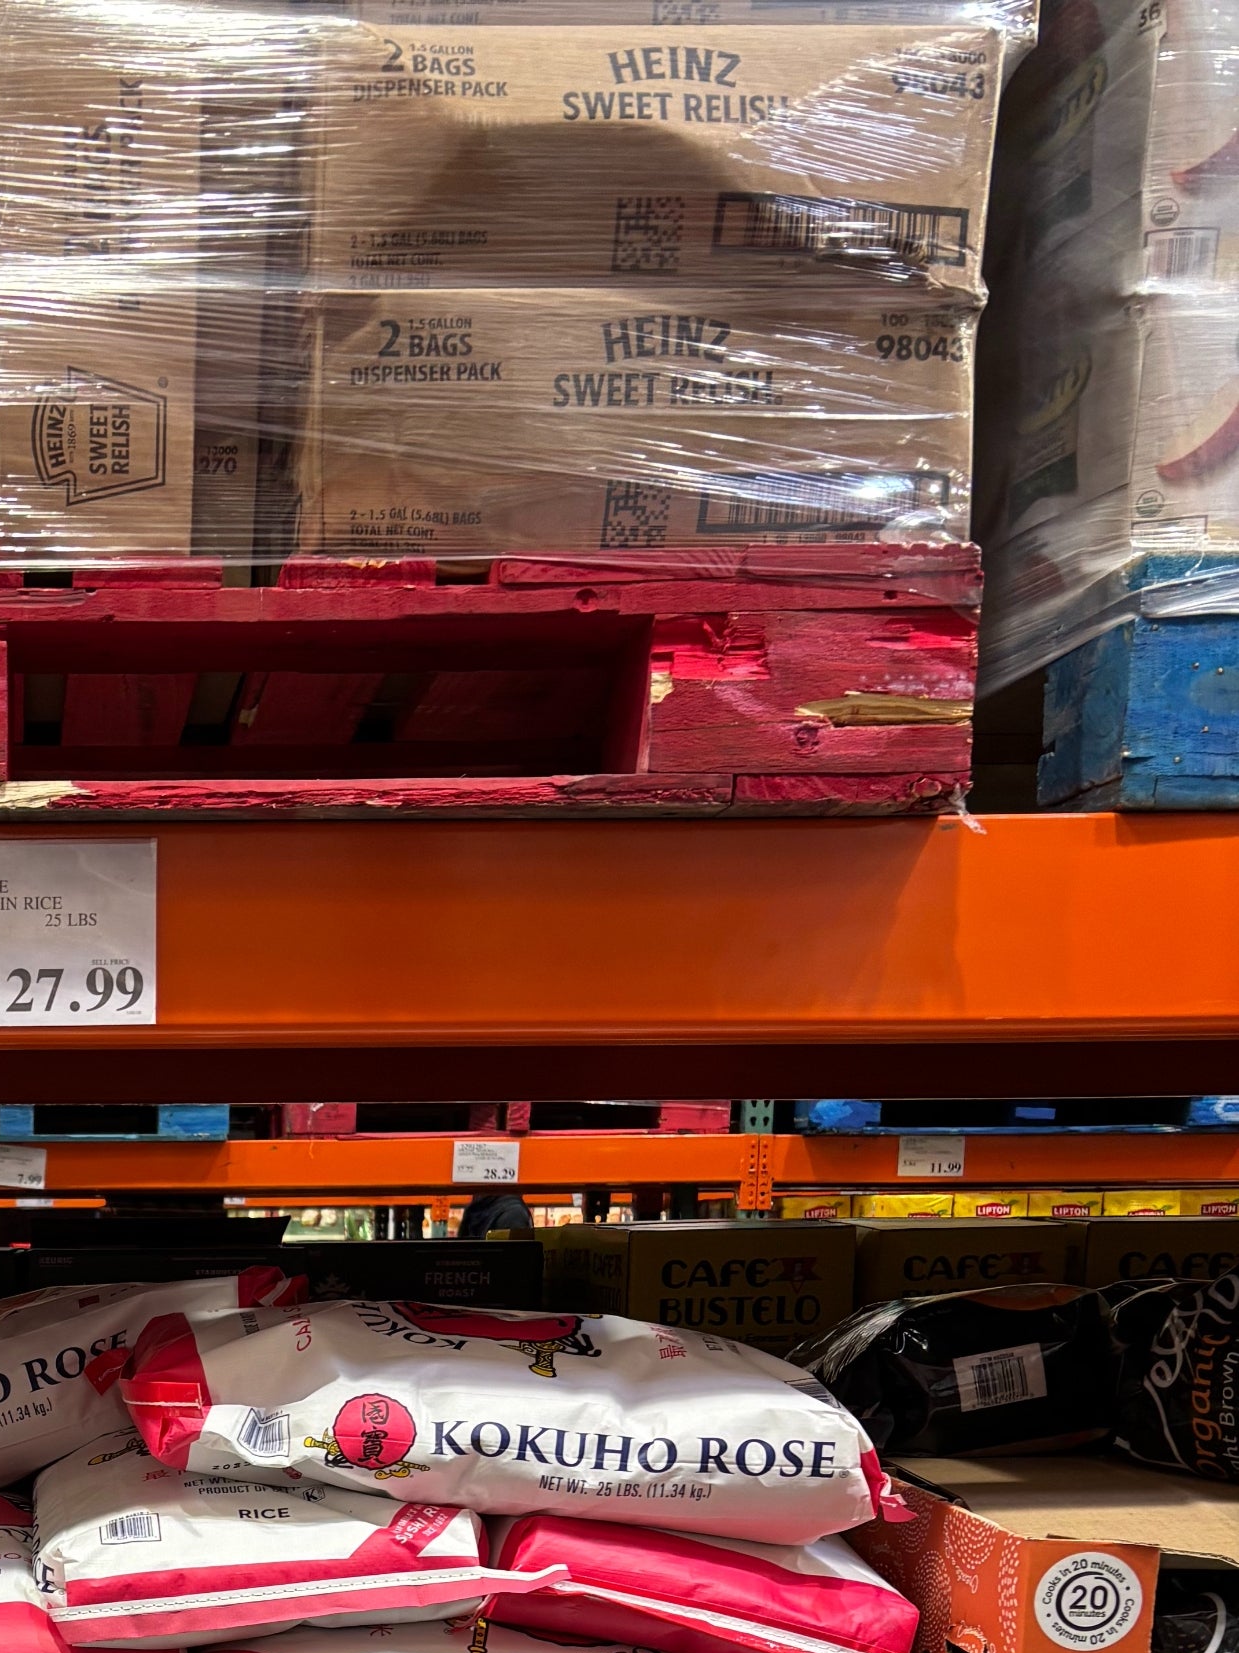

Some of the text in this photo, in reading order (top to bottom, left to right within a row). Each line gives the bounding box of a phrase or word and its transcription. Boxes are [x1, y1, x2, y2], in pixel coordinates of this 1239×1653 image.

[412, 55, 476, 76] BAGS
[607, 46, 742, 88] HEINZ
[563, 92, 672, 122] SWEET
[429, 318, 472, 330] GALLON
[408, 333, 472, 357] BAGS
[351, 361, 502, 385] DISPENSER PACK
[46, 404, 67, 470] HEINZ
[89, 404, 108, 476] SWEET
[110, 404, 130, 475] RELISH
[23, 897, 62, 910] RICE
[45, 913, 97, 927] 25 LBS
[6, 966, 144, 1013] 27.99
[483, 1168, 515, 1180] 28.29
[931, 1162, 961, 1173] 11.99
[976, 1205, 1010, 1215] LIPTON
[1052, 1206, 1089, 1217] LIPTON
[424, 1271, 491, 1286] FRENCH
[660, 1295, 820, 1326] BUSTELO
[431, 1419, 839, 1483] KOKUHO ROSE
[539, 1475, 713, 1502] NET WT. 25 LBS. (11.34 kg.)
[238, 1508, 290, 1519] RICE
[1069, 1585, 1108, 1610] 20
